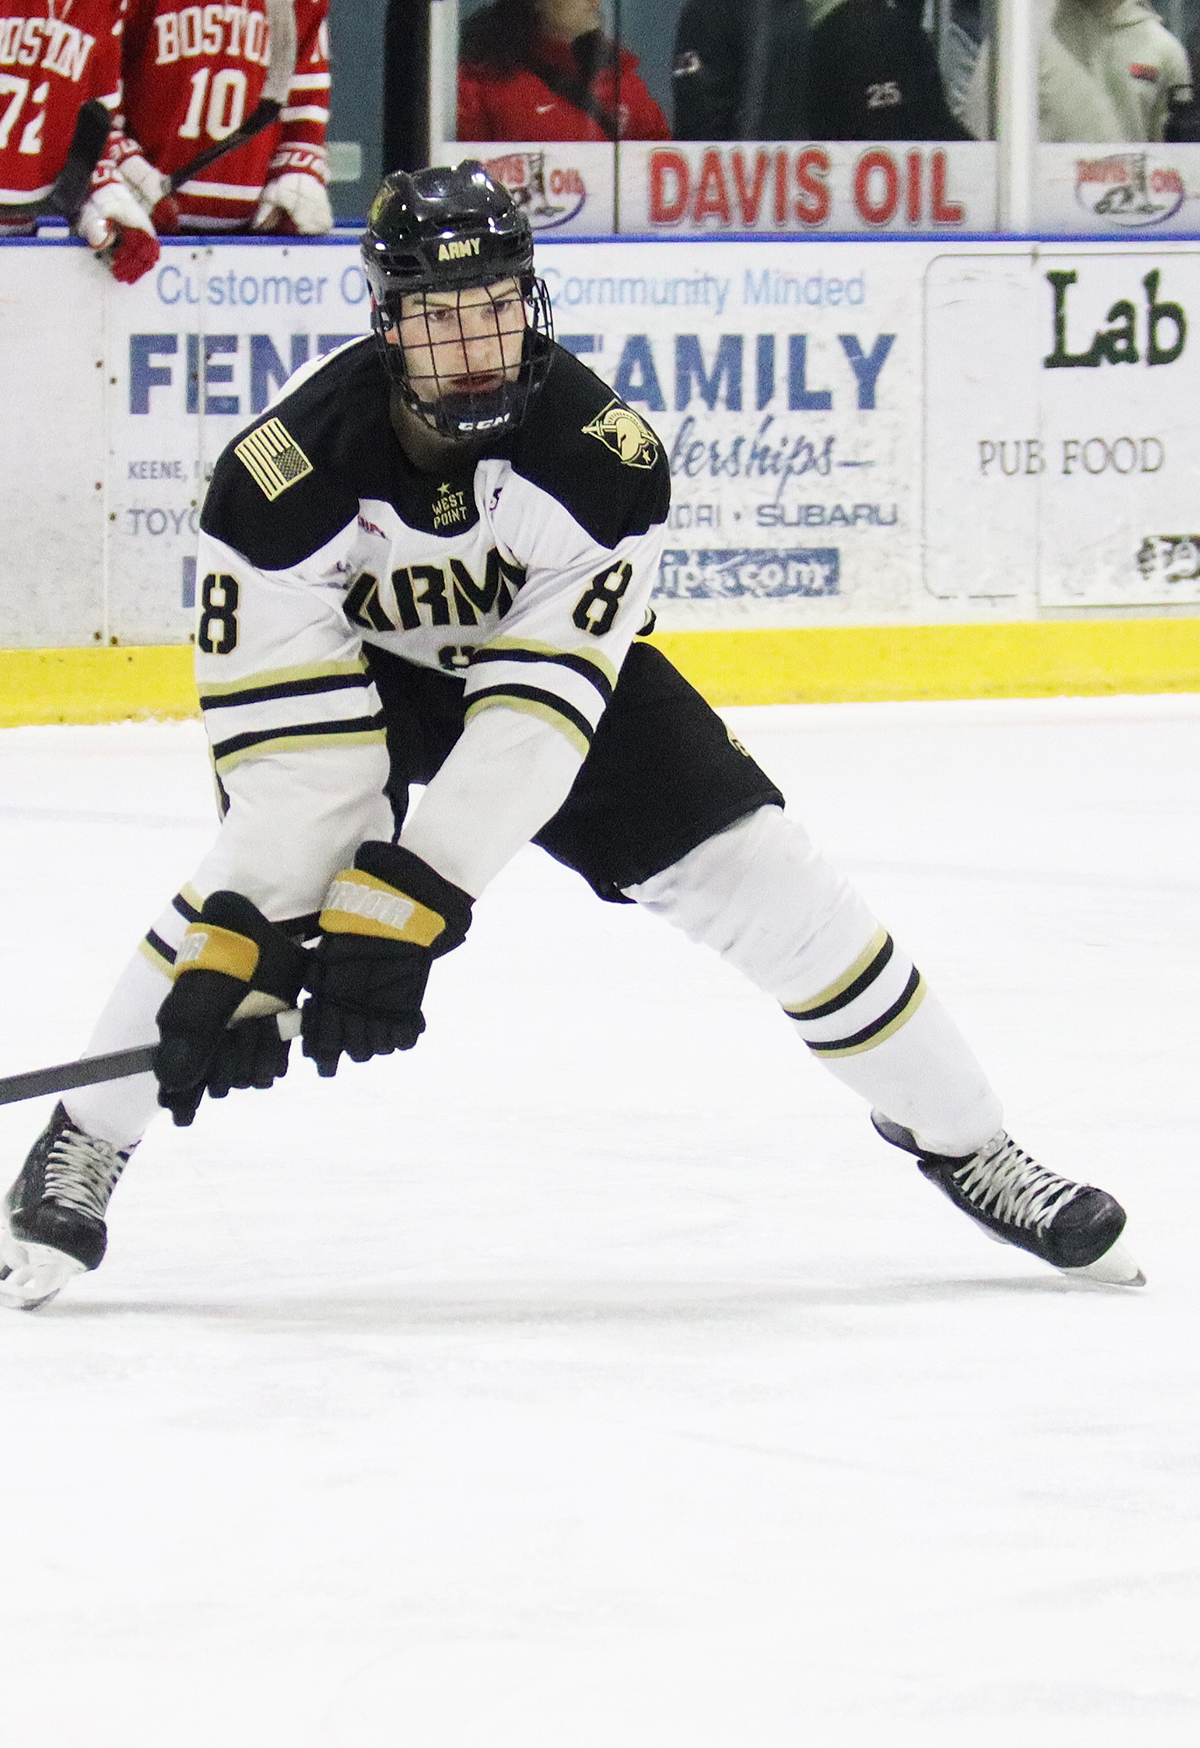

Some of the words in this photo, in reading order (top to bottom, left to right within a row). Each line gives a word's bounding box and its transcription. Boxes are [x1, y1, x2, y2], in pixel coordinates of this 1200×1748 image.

[154, 4, 270, 66] BOSTO
[178, 68, 247, 141] 10
[649, 147, 832, 228] DAVIS
[854, 147, 964, 227] OIL
[438, 238, 480, 261] ARMY
[157, 265, 328, 305] Customer
[538, 267, 730, 315] Community
[744, 269, 867, 306] Minded
[1043, 267, 1188, 369] Lab
[129, 333, 372, 415] FEN
[458, 413, 510, 431] CCM
[128, 460, 188, 483] KEENE,
[671, 414, 836, 505] lerships
[978, 439, 1046, 476] PUB
[1061, 437, 1164, 475] FOOD
[127, 508, 199, 536] TOY
[432, 491, 465, 516] WEST
[433, 506, 468, 530] POINT
[756, 503, 899, 528] SUBARU
[199, 572, 240, 655] 8
[342, 546, 528, 633] ARM
[571, 559, 633, 637] 8
